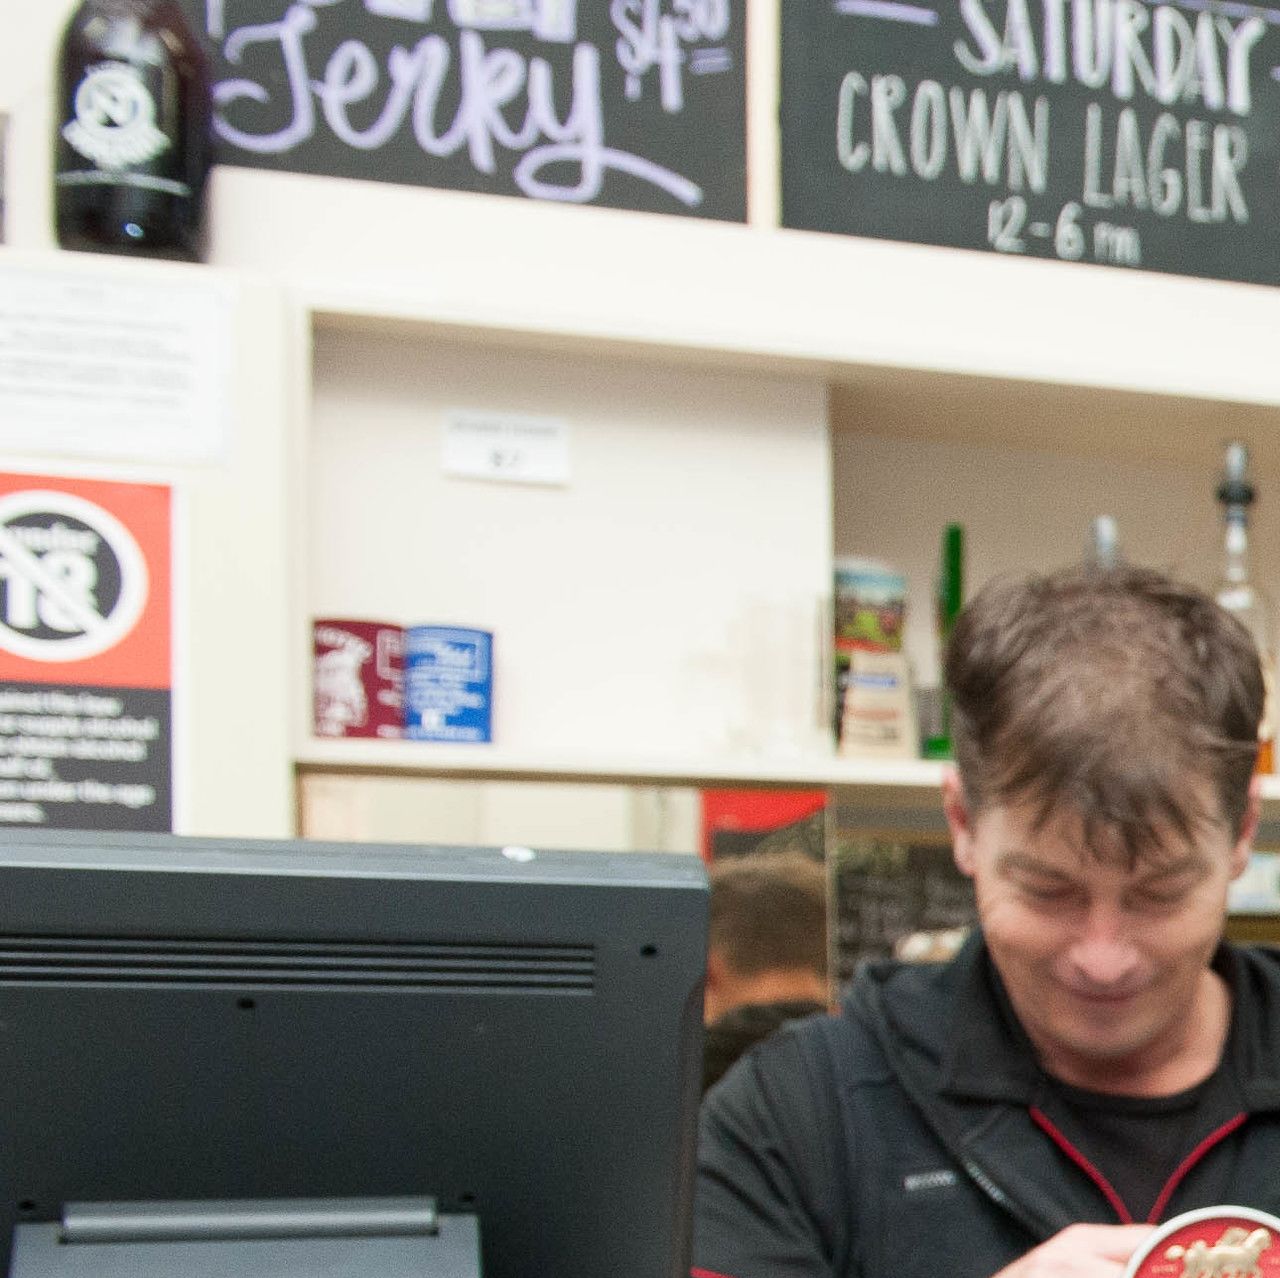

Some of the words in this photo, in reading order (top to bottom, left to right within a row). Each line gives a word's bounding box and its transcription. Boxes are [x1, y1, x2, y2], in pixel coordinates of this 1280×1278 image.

[209, 12, 700, 204] Jerky
[953, 0, 1267, 116] SATURDAY
[836, 71, 1050, 193] CROWN
[1082, 101, 1250, 224] LAGER
[987, 195, 1086, 260] 12-6
